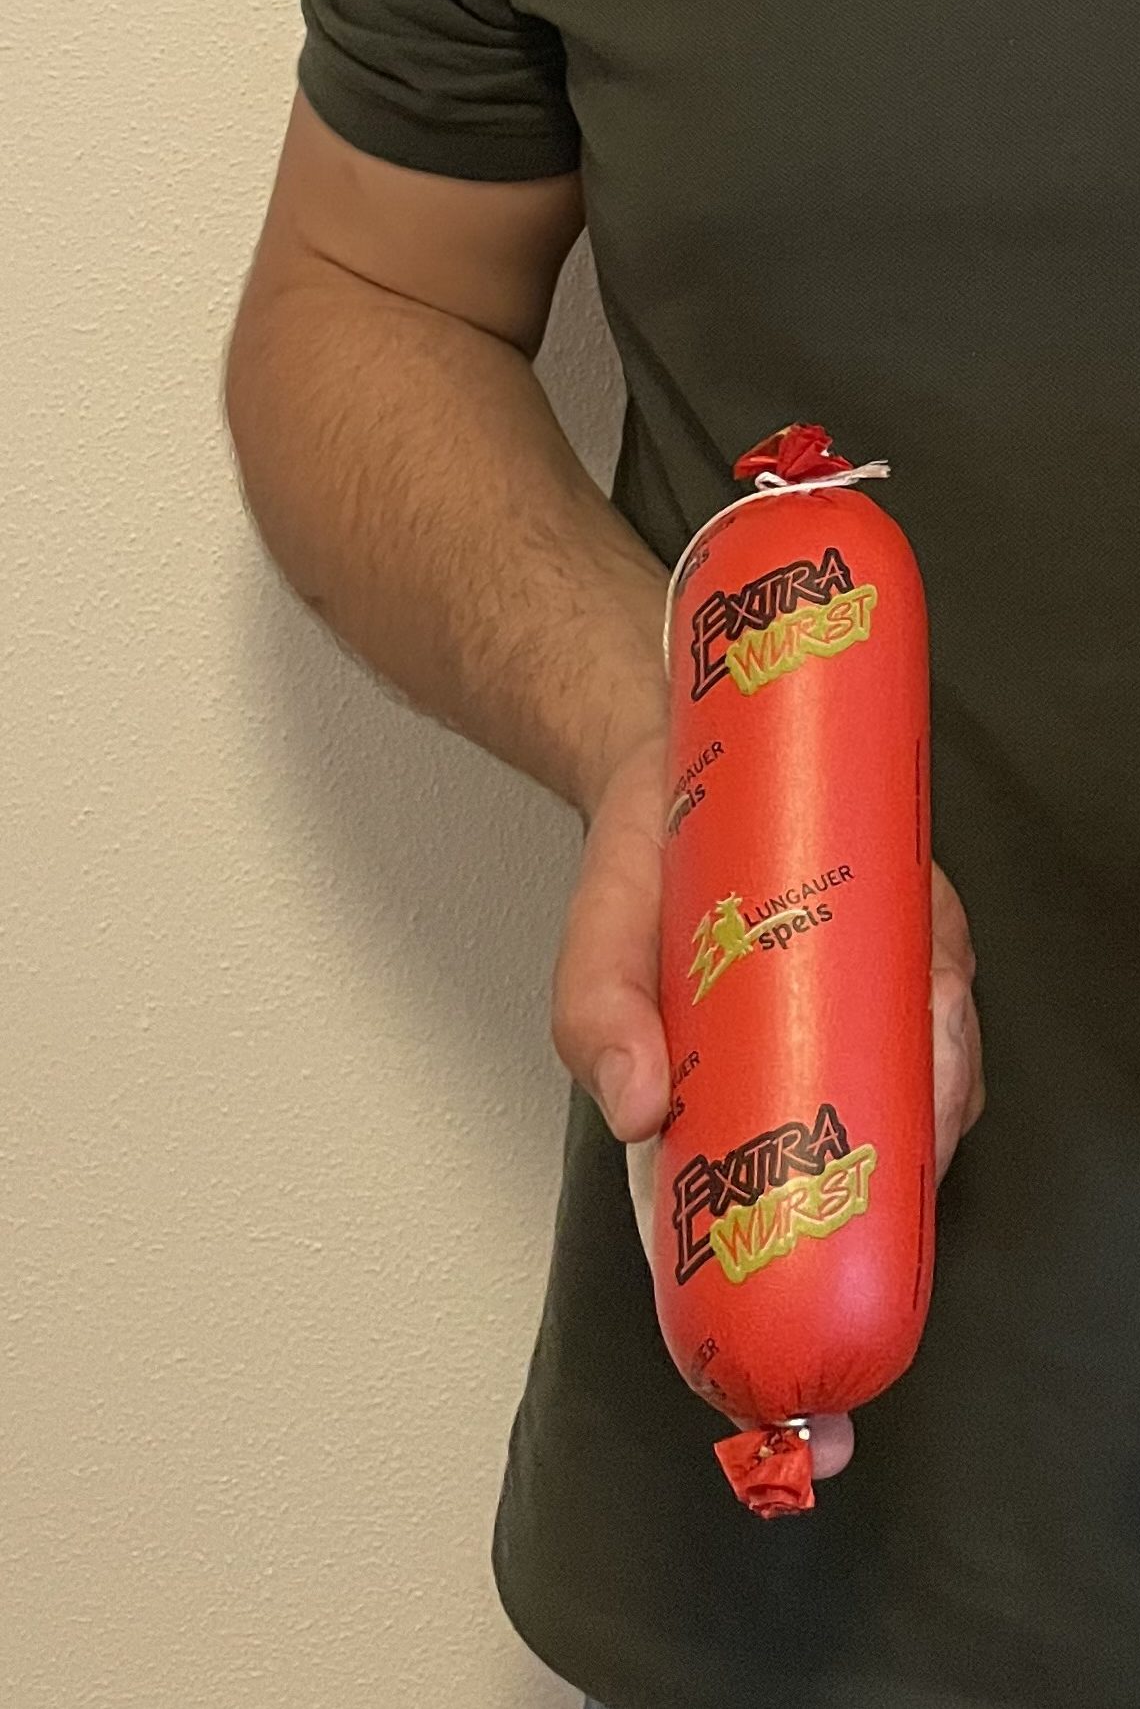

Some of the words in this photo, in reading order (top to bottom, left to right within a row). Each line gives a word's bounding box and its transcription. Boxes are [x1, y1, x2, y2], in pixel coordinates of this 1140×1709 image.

[690, 547, 853, 701] EXTRA
[725, 584, 877, 696] WURST
[744, 865, 855, 927] LUNGAUER
[758, 903, 833, 950] speis
[672, 1104, 850, 1285] EXTRA
[709, 1144, 877, 1284] WURST
